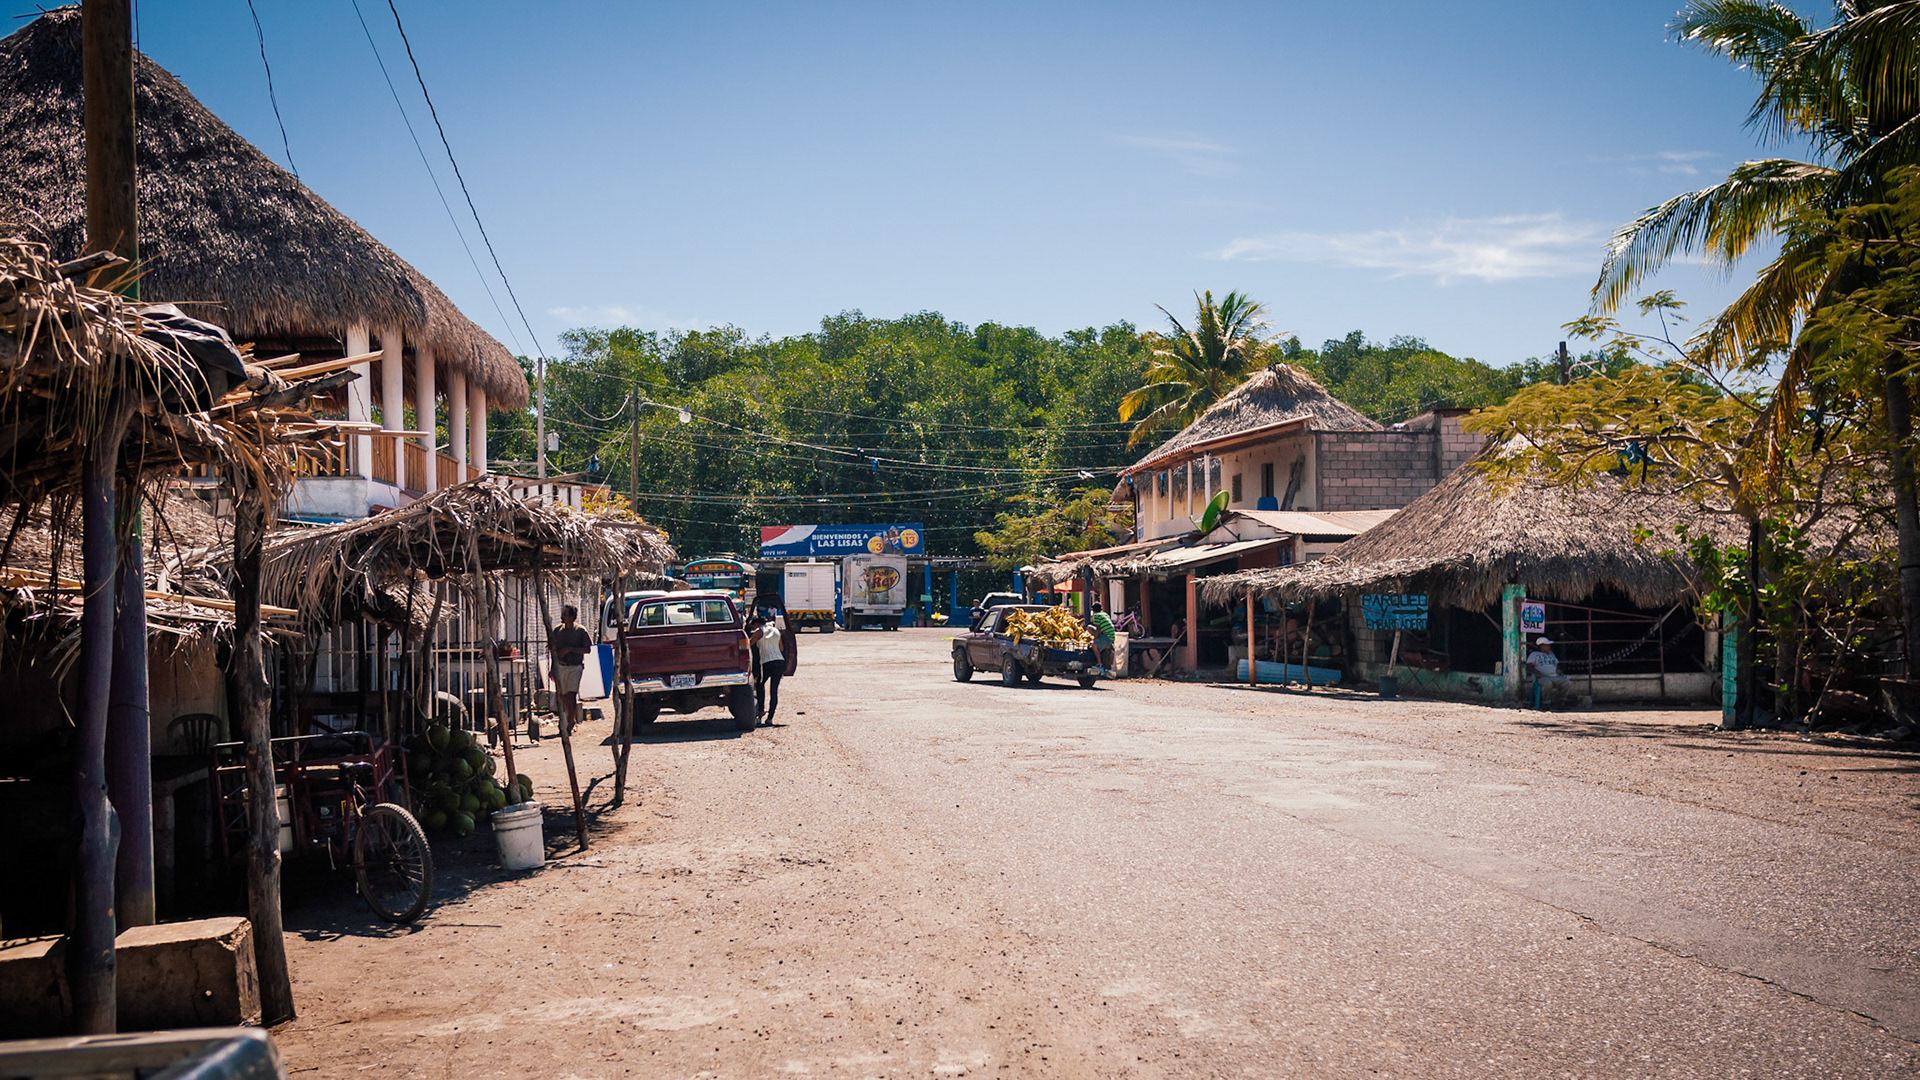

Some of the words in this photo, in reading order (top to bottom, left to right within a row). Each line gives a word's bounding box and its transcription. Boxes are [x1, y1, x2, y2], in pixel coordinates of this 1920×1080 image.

[811, 533, 861, 541] BIENVENIDOS
[837, 539, 863, 547] LISAS
[871, 575, 898, 589] Rey
[1362, 594, 1428, 608] PARQUEO
[1523, 621, 1542, 629] SAL
